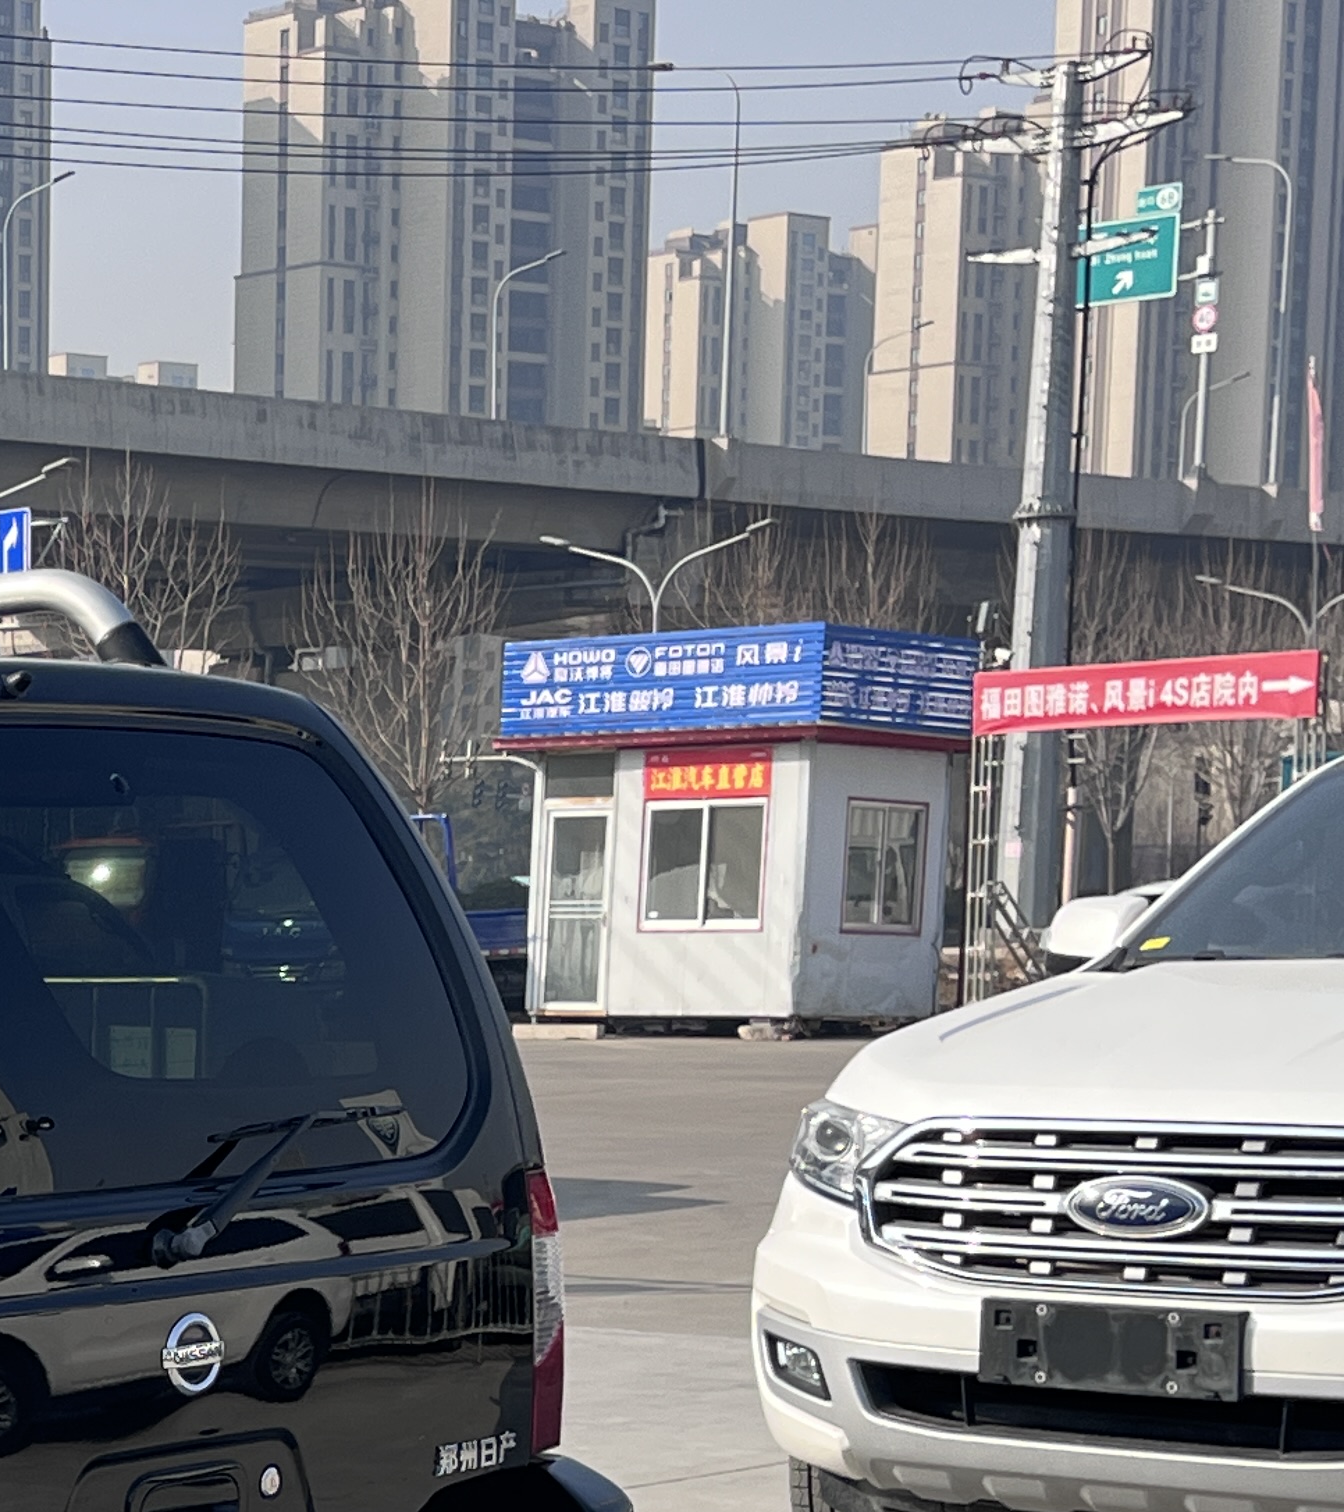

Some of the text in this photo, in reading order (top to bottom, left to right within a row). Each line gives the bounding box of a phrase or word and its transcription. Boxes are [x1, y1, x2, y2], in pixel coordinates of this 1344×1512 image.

[553, 648, 616, 666] HOWO
[654, 643, 726, 659] FOTON
[520, 688, 573, 706] JAC
[650, 762, 765, 791] 江淮汽车直营店
[1095, 1188, 1170, 1222] Ford
[173, 1345, 221, 1364] NISSAN
[435, 1430, 517, 1477] 郑州日产
